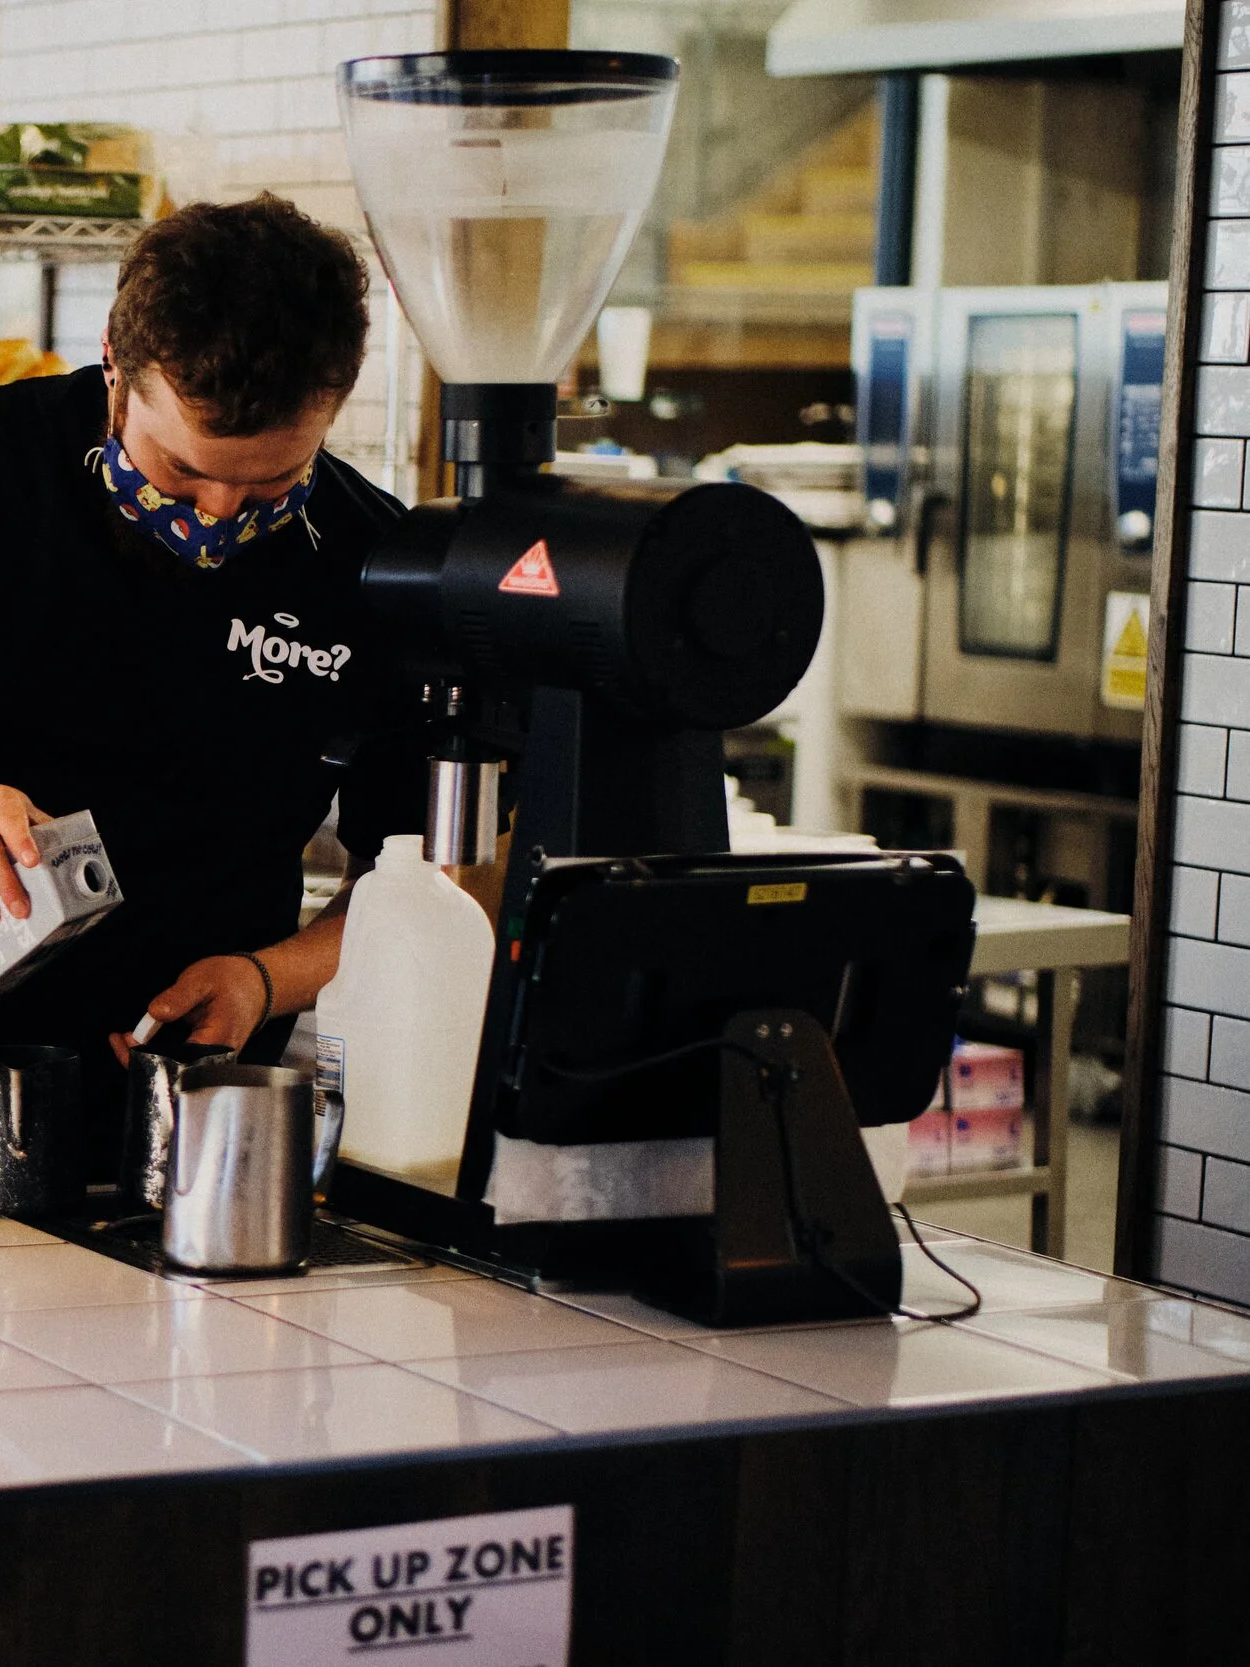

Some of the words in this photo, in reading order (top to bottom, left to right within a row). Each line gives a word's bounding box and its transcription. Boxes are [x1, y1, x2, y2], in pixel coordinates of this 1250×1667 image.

[227, 613, 352, 684] More?
[254, 1557, 354, 1601] PICK
[372, 1550, 431, 1590] UP
[444, 1534, 565, 1582] ZONE
[349, 1594, 474, 1643] ONLY
